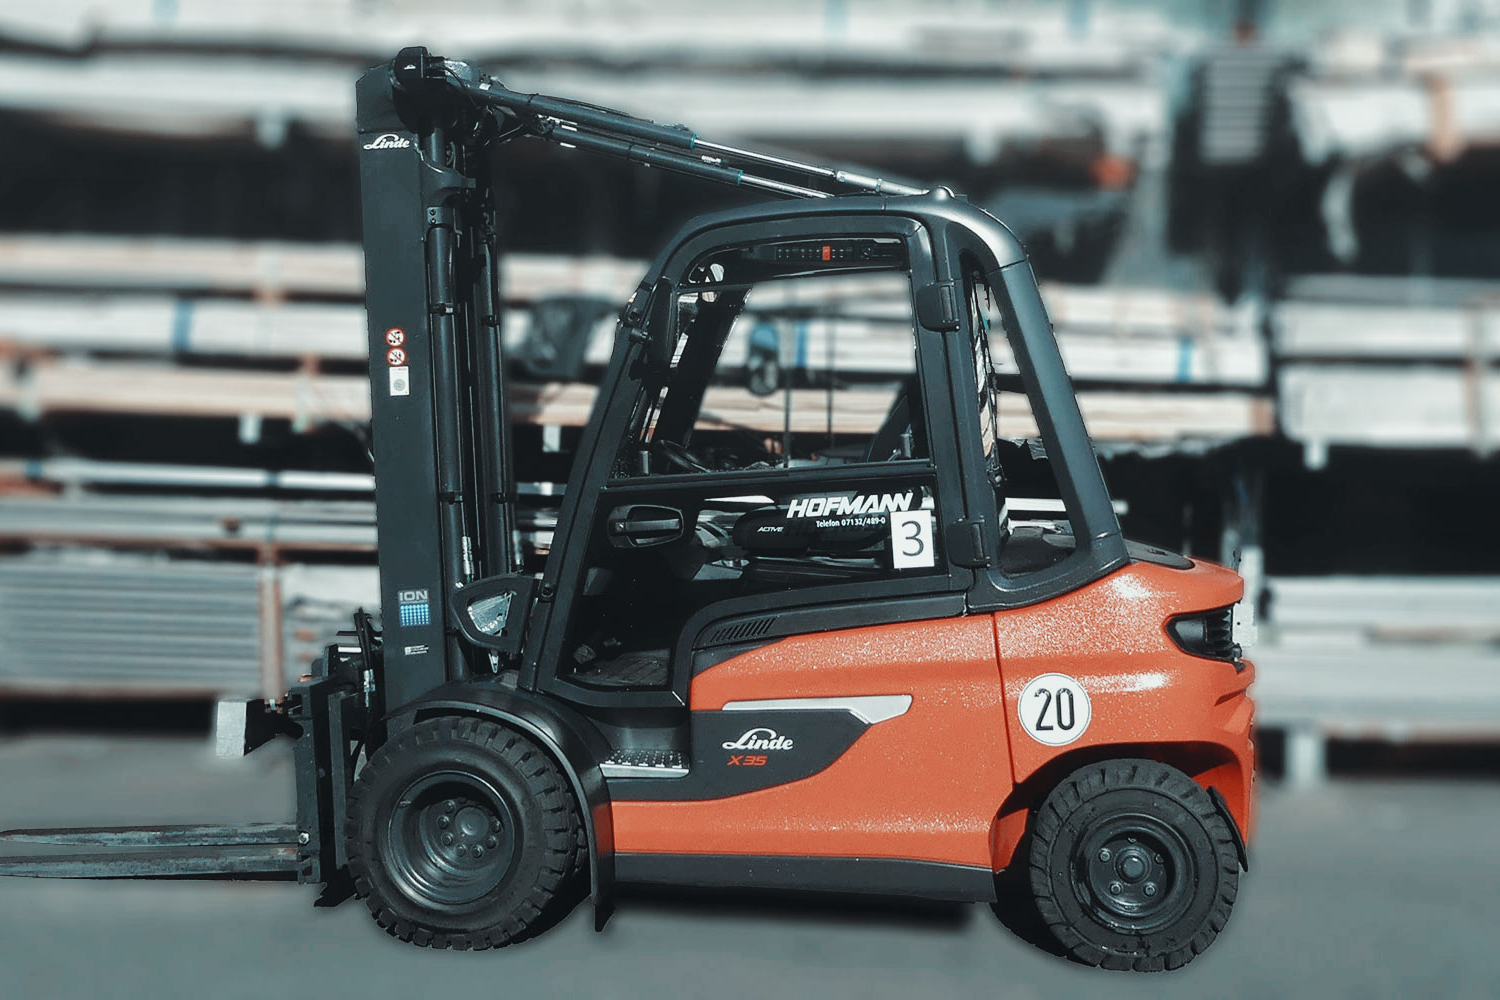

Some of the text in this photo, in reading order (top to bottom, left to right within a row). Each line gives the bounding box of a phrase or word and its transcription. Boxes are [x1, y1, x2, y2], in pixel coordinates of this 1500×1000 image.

[363, 133, 410, 149] Linde
[786, 492, 914, 518] HOFMANN
[816, 519, 840, 528] Telefon
[901, 520, 925, 556] 3
[399, 590, 429, 601] ION
[1034, 687, 1075, 731] 20
[722, 727, 794, 750] Linde
